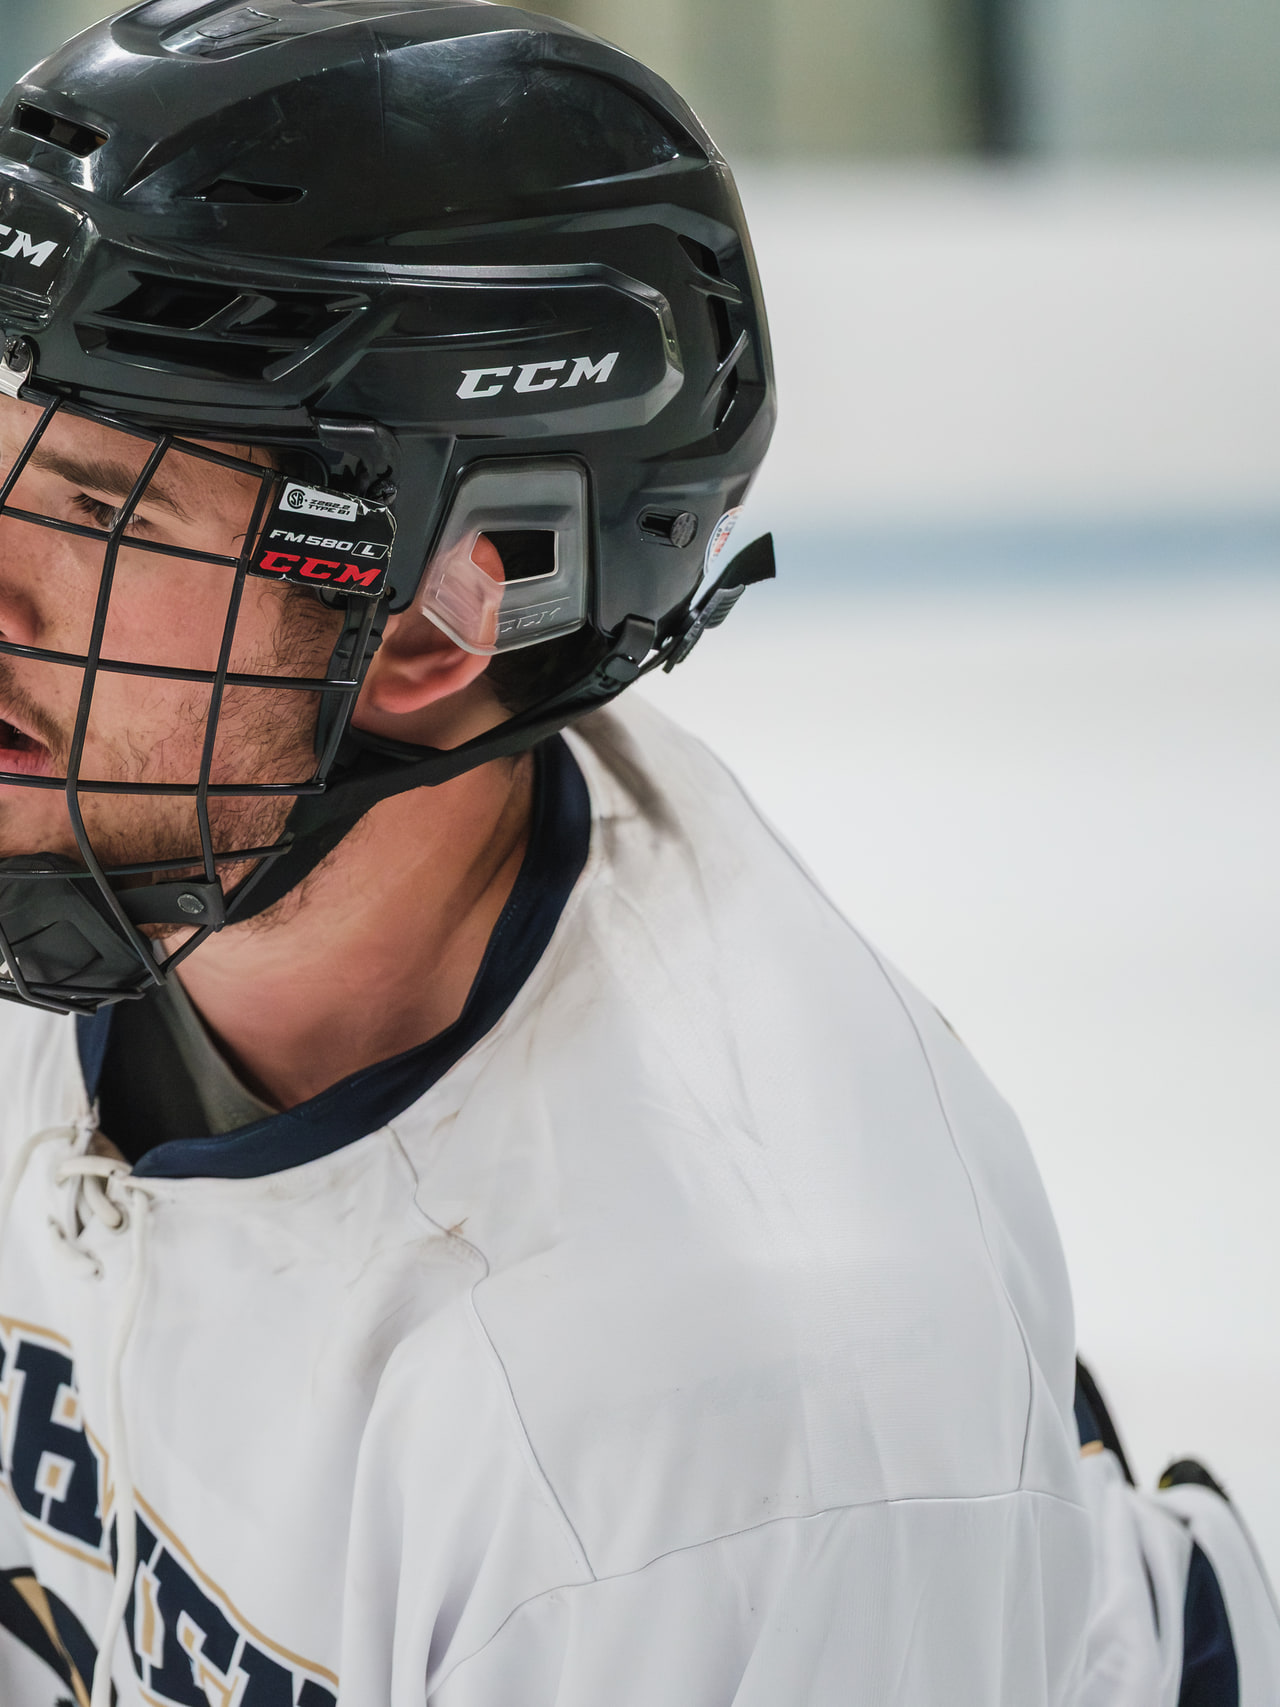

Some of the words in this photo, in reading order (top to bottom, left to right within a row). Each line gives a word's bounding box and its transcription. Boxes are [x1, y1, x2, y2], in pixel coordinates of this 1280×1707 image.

[456, 351, 620, 400] CCM
[308, 503, 337, 513] TYPE
[361, 544, 375, 556] L
[259, 550, 382, 587] CCM
